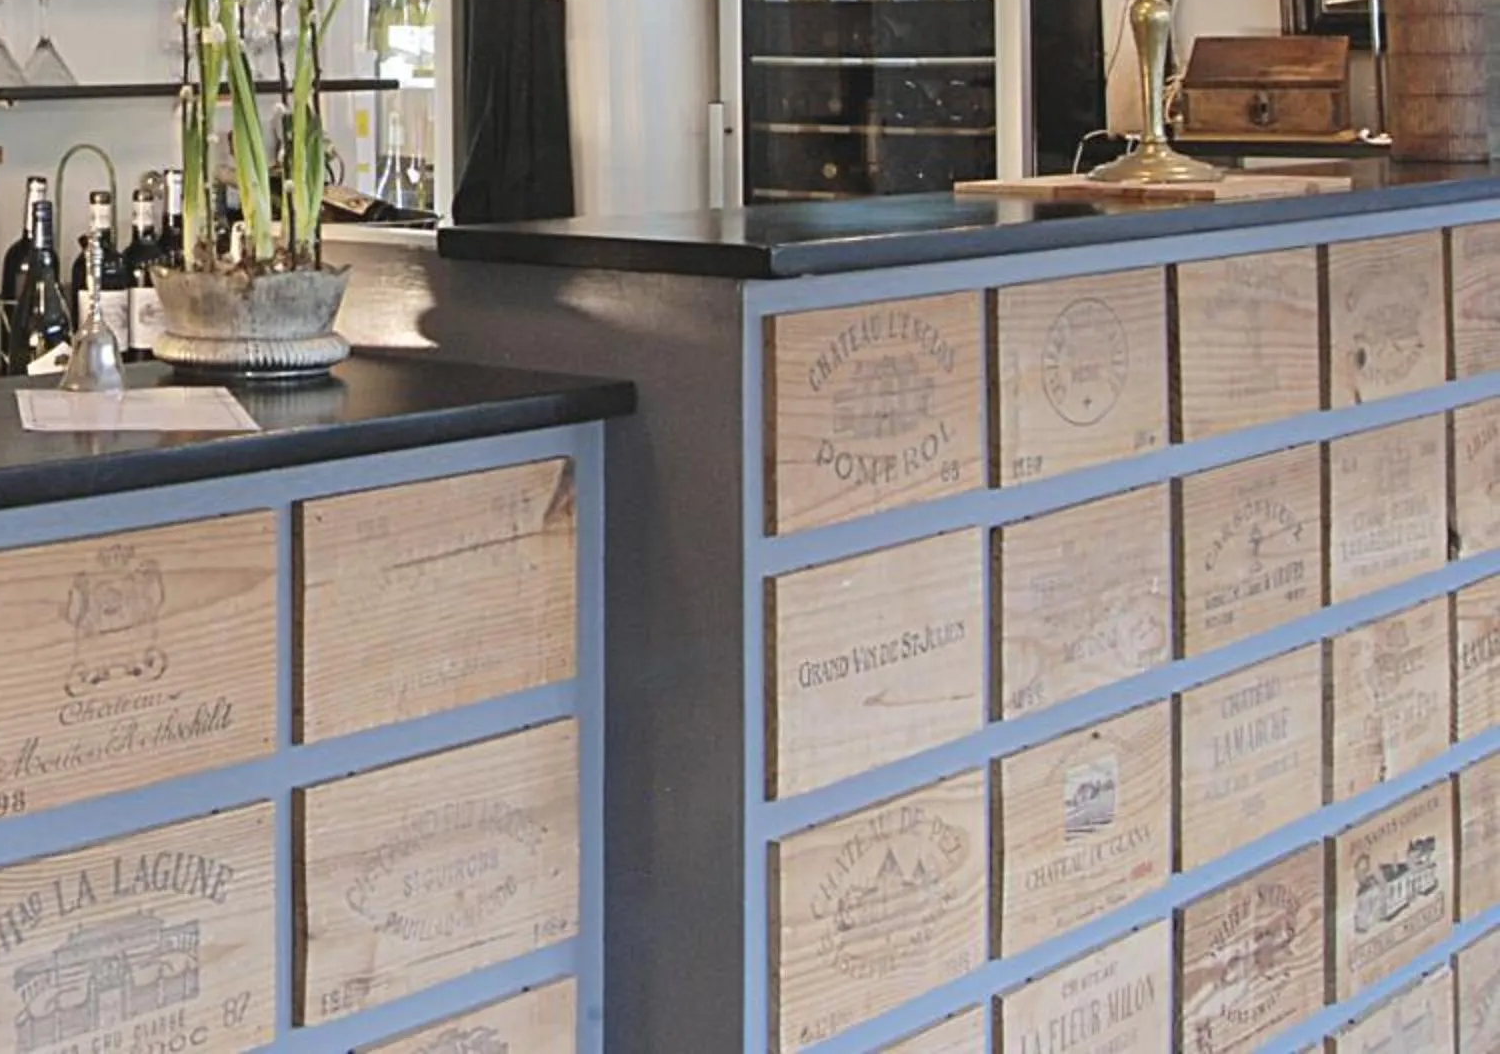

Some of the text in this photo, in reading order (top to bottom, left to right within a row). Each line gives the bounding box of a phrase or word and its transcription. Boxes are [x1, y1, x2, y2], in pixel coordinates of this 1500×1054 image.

[815, 420, 956, 487] POMEROL
[797, 654, 850, 690] GRAND
[899, 805, 925, 835] DE
[51, 868, 98, 918] LA
[111, 849, 236, 907] LAGUNE
[1046, 998, 1102, 1054] FLEUR
[1105, 972, 1156, 1030] MILON
